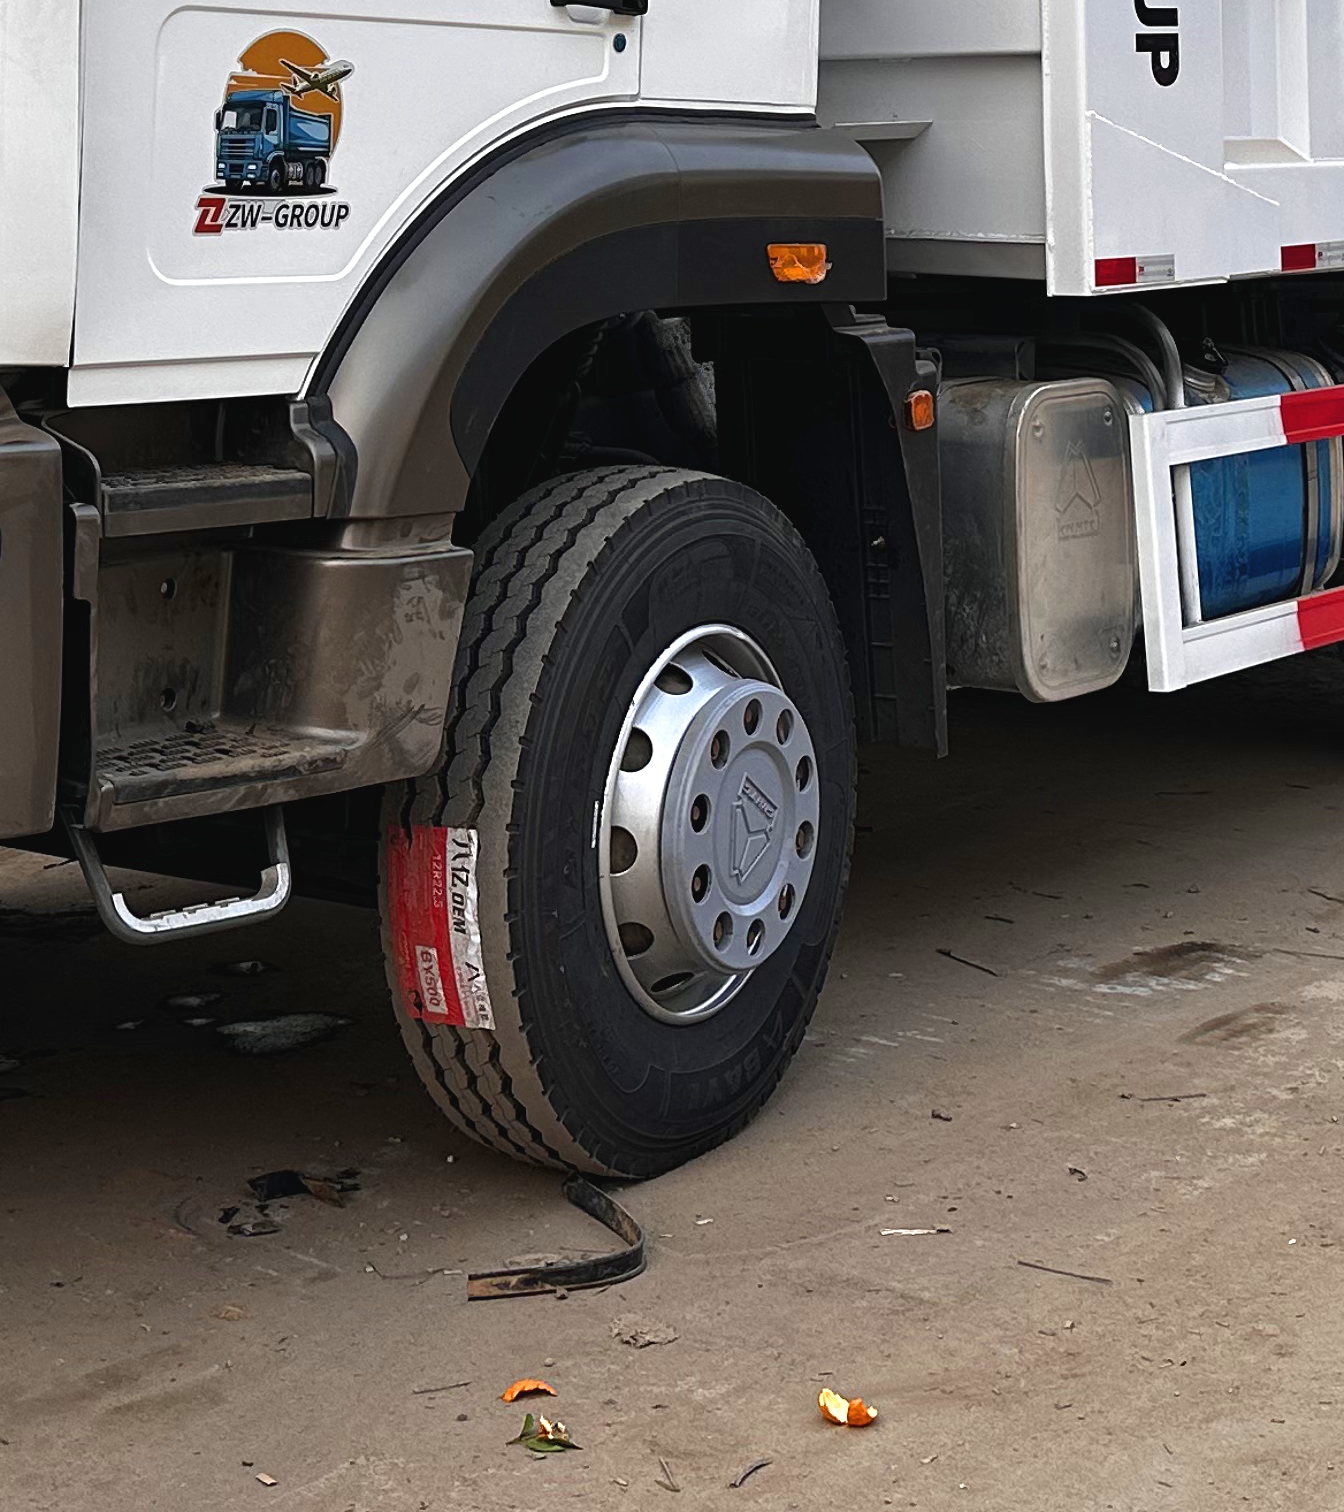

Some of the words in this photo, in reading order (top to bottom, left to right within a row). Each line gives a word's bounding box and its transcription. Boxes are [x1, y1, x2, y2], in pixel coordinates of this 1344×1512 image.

[224, 202, 350, 228] ZW-GROUP
[430, 854, 444, 909] 12R22.5
[450, 892, 468, 935] OEM
[419, 950, 441, 1008] BY500
